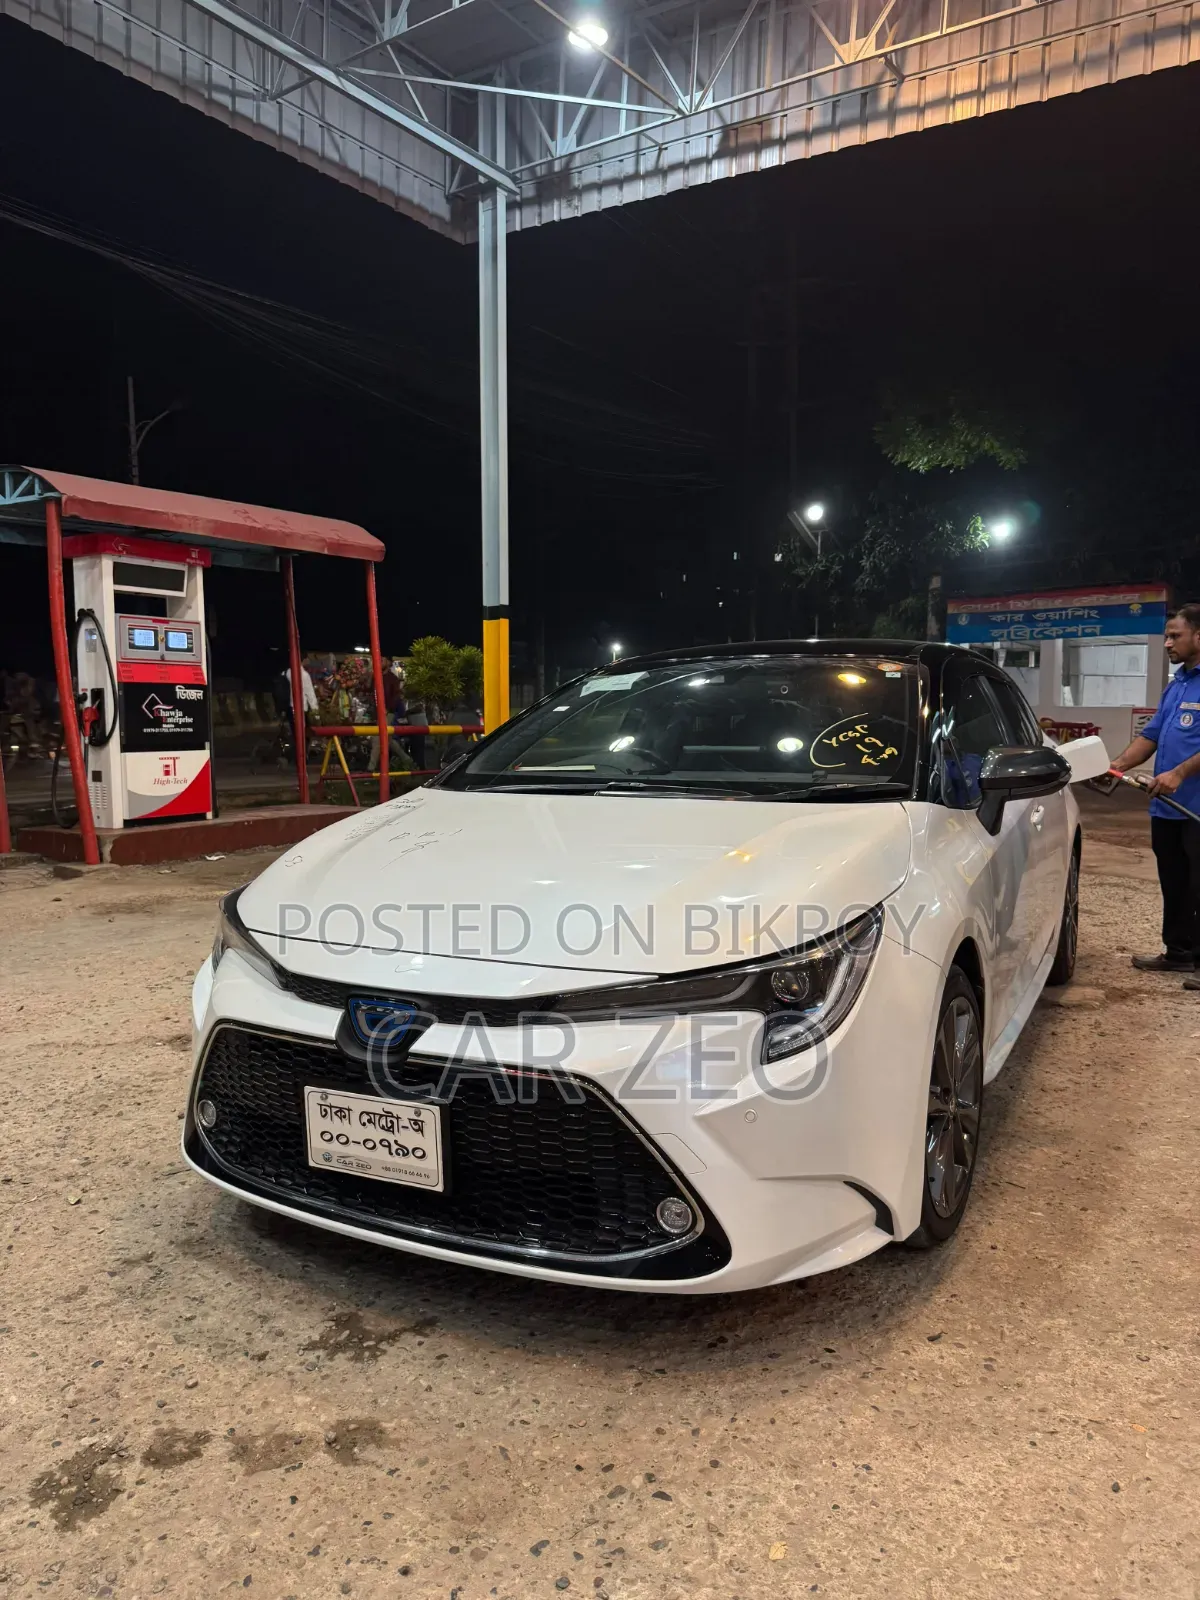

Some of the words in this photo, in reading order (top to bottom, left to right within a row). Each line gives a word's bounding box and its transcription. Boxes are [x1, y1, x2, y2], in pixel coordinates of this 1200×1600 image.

[988, 613, 1024, 623] কার
[1032, 608, 1100, 621] ওয়াশিং
[989, 624, 1104, 641] লুব্রিকেশন
[175, 684, 204, 701] ডিজেল
[153, 709, 183, 719] Khawja
[162, 716, 194, 725] Enterprise
[153, 777, 188, 786] High-Tech
[317, 1102, 353, 1126] ঢাকা
[358, 1108, 425, 1138] মেট্রো-অ
[320, 1130, 426, 1160] ০০-০৭৯০
[336, 1158, 354, 1167] CAR
[355, 1161, 372, 1170] ZEO
